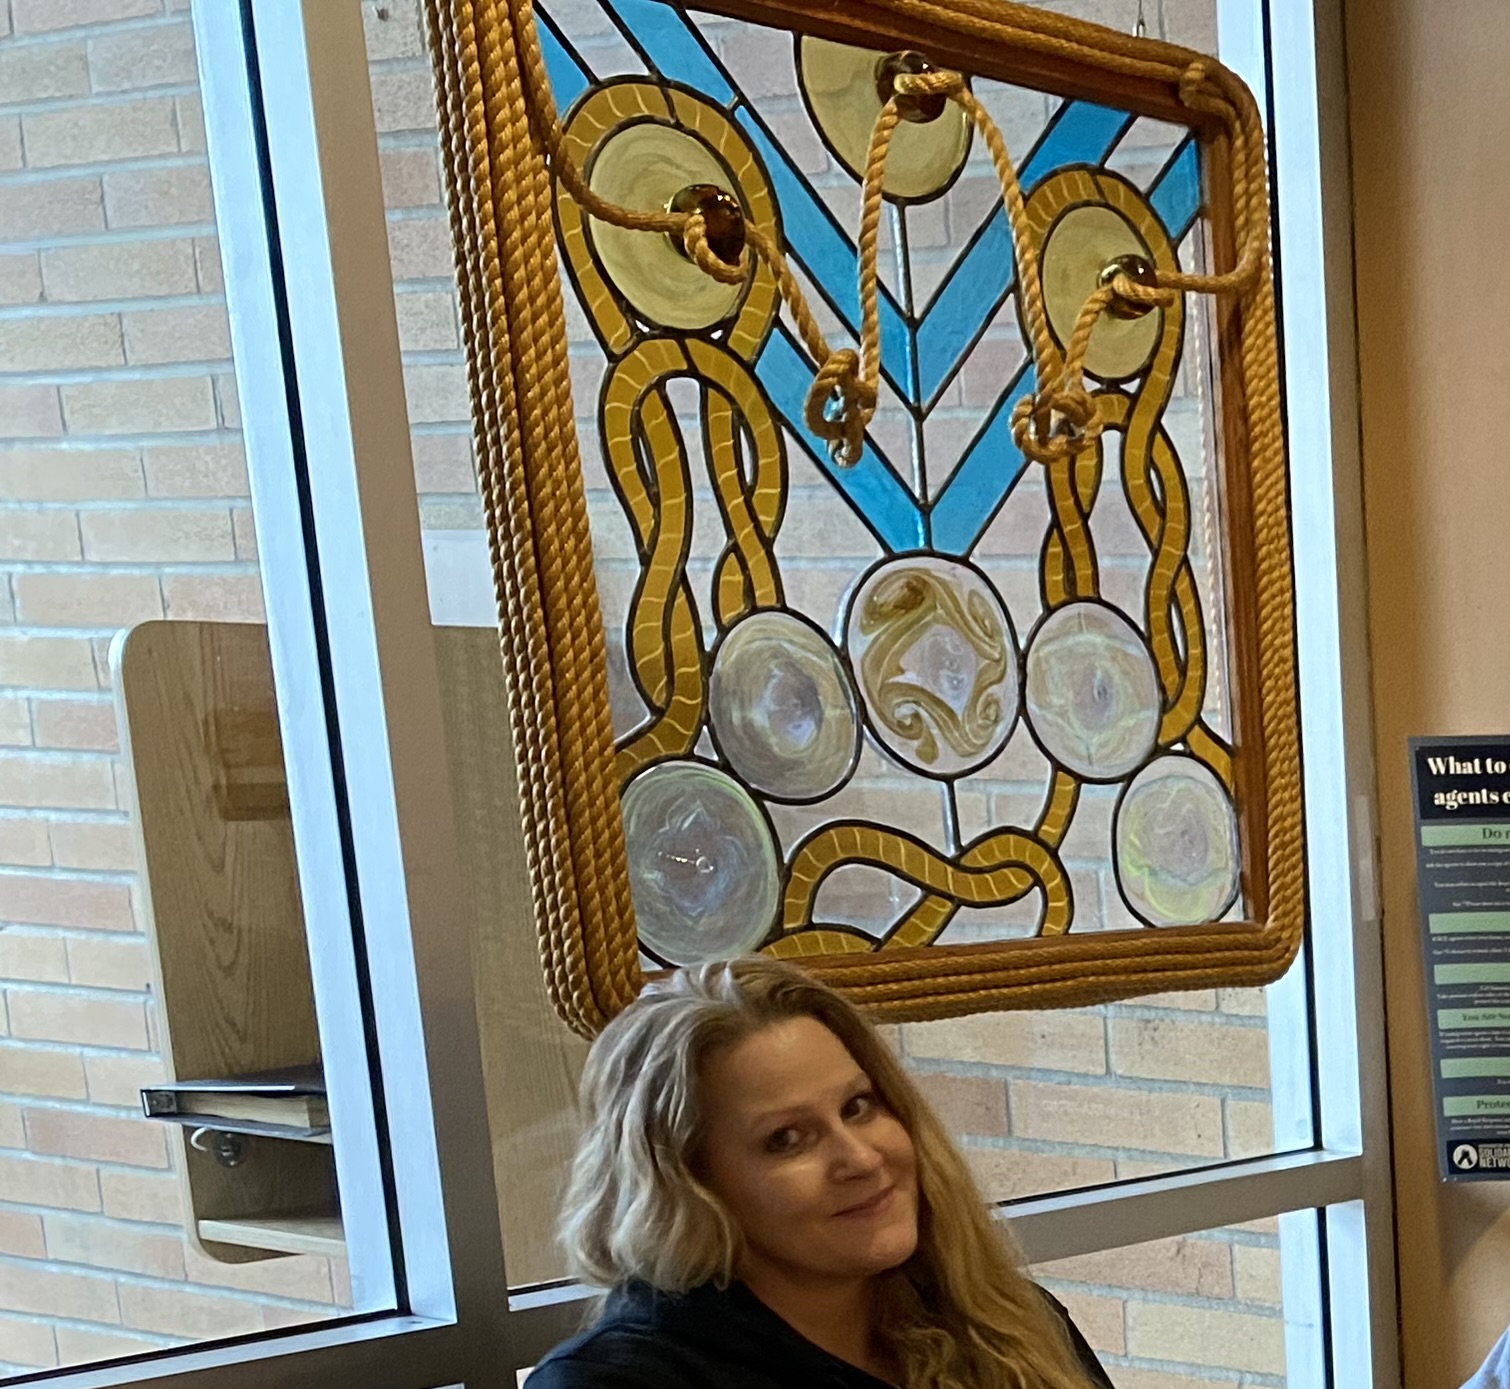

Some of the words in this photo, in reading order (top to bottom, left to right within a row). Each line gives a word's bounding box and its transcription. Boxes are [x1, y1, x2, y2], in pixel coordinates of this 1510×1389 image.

[1427, 756, 1482, 776] What
[1485, 756, 1507, 775] to
[1433, 788, 1499, 811] agents
[1481, 827, 1503, 840] Do
